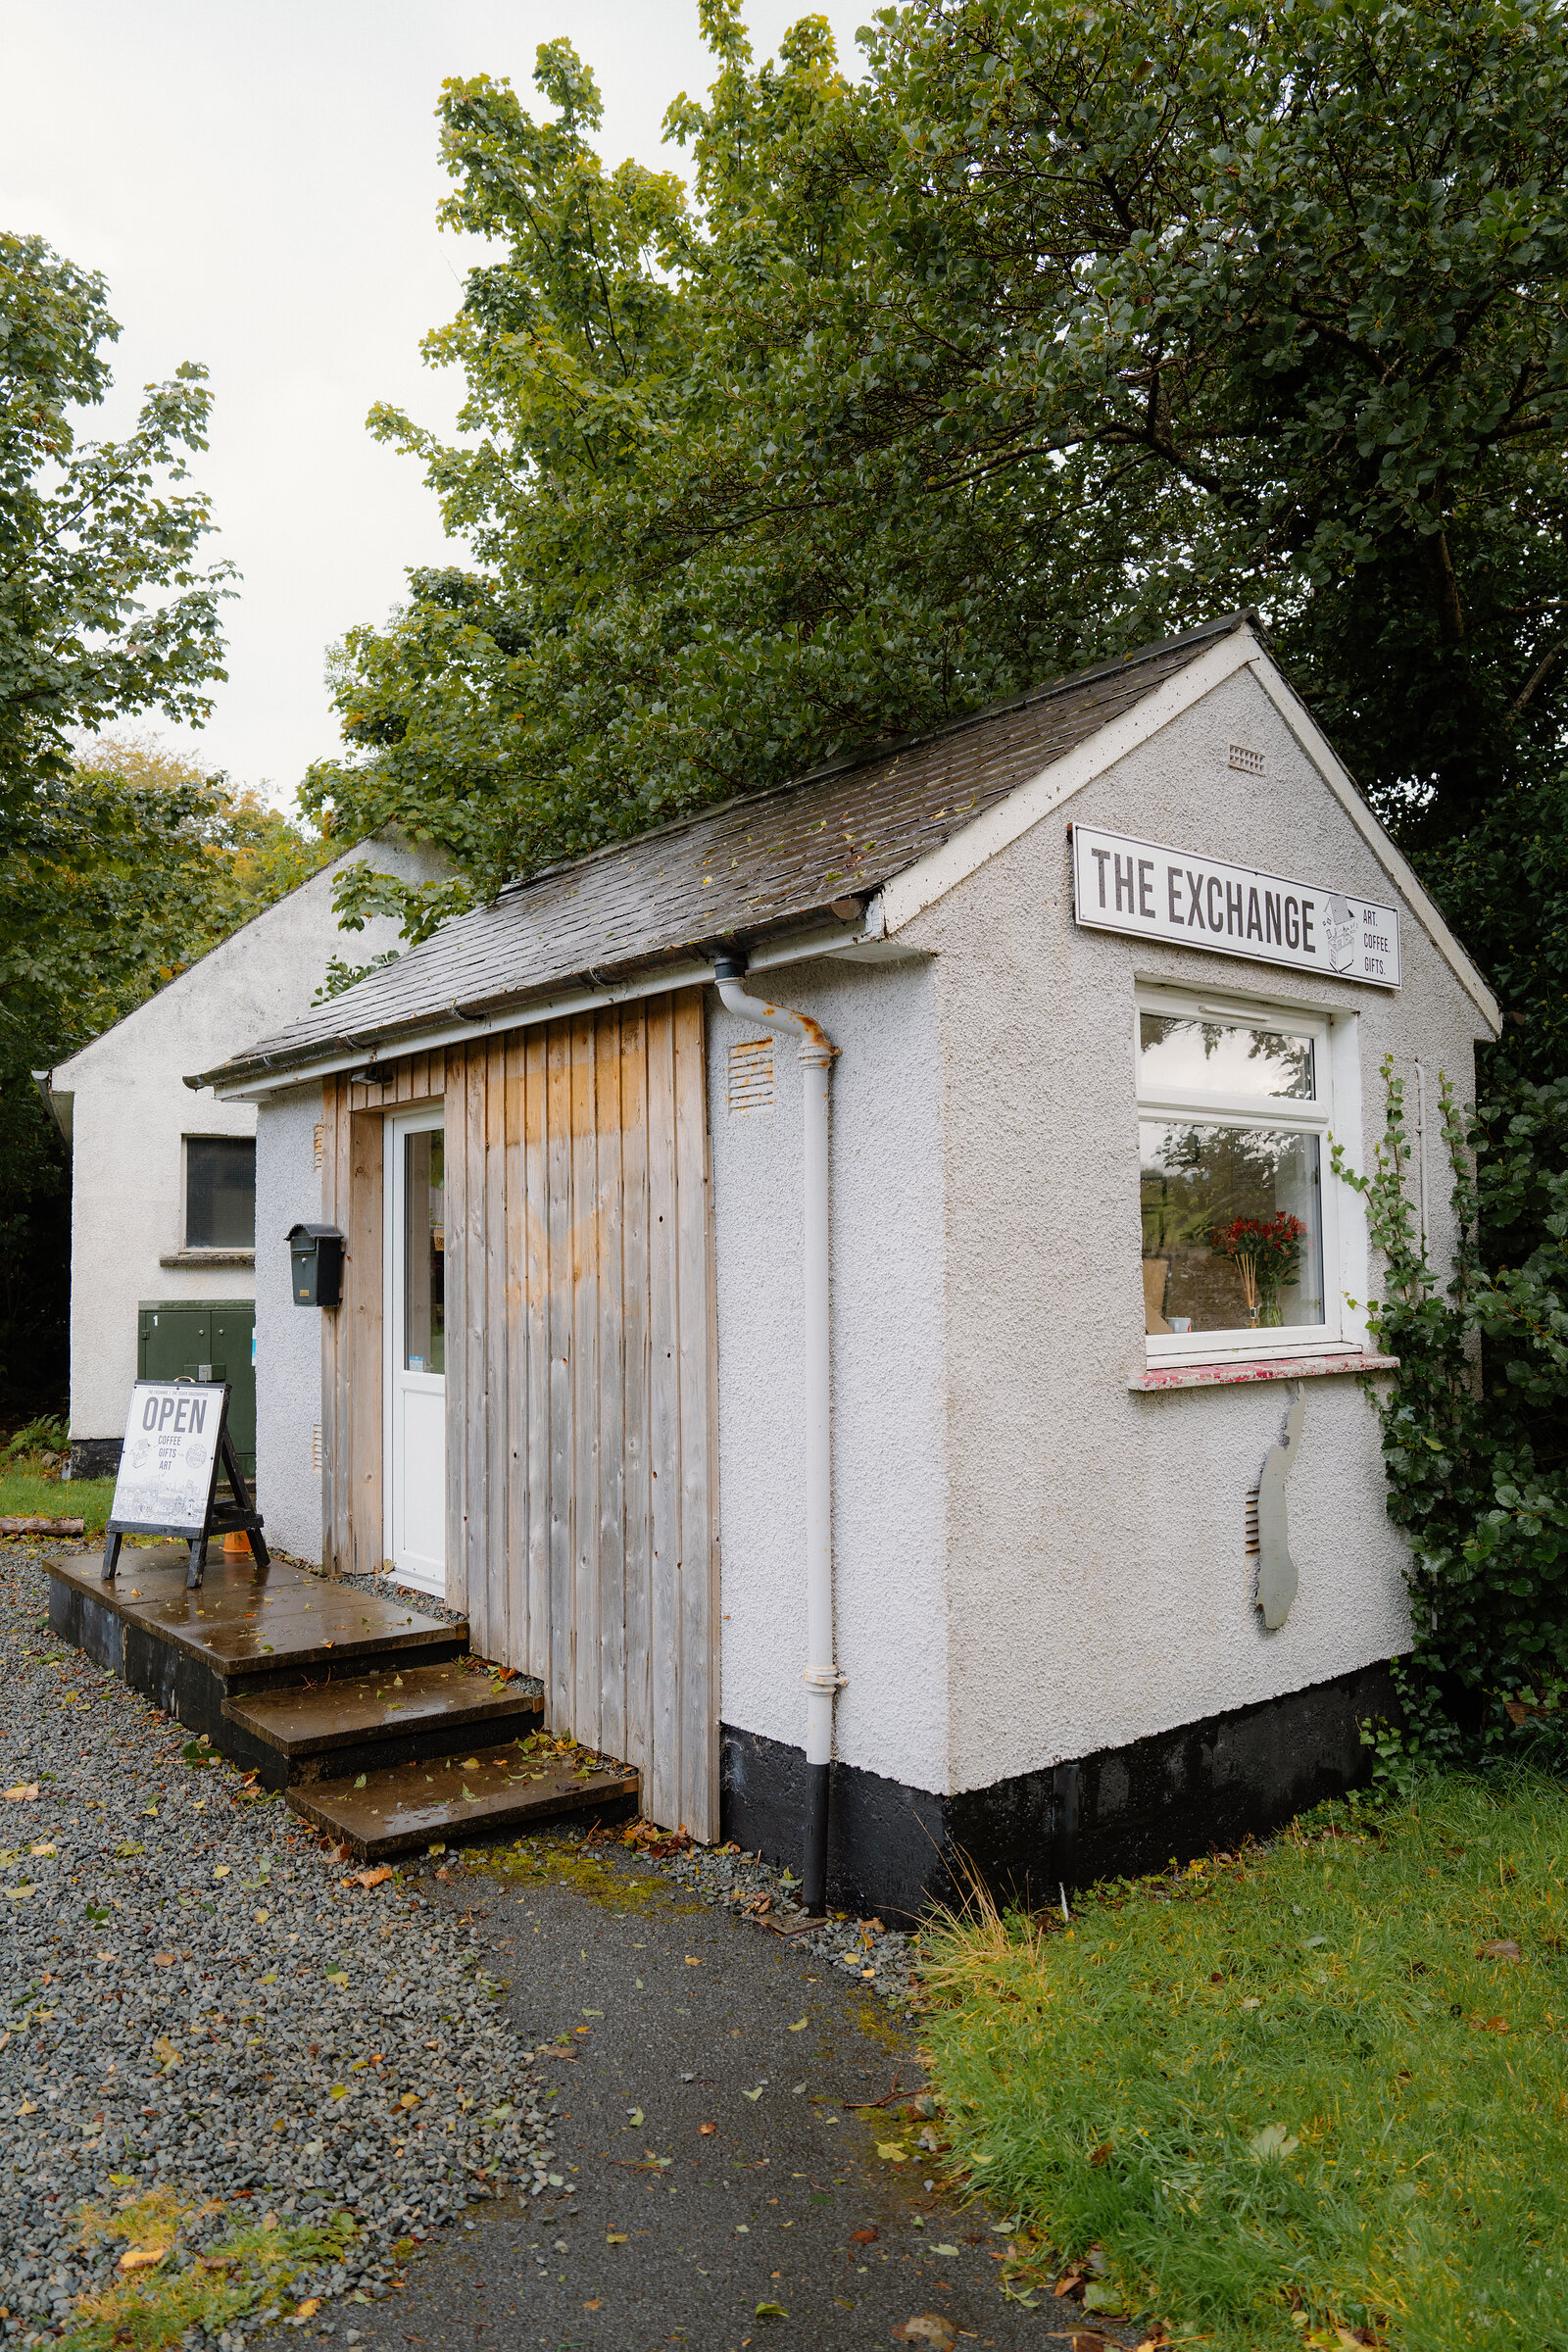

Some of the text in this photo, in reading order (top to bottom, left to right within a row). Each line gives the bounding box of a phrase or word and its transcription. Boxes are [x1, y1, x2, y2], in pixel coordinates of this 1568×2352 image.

[1091, 848, 1316, 954] THE EXCHANGE
[1362, 908, 1378, 927] ART.
[1363, 933, 1391, 954] COFFEE.
[1363, 956, 1386, 975] GIFTS.
[142, 1396, 208, 1434] OPEN
[158, 1435, 182, 1446] COFFEE
[158, 1447, 177, 1458] GIFTS
[158, 1460, 172, 1470] ART
